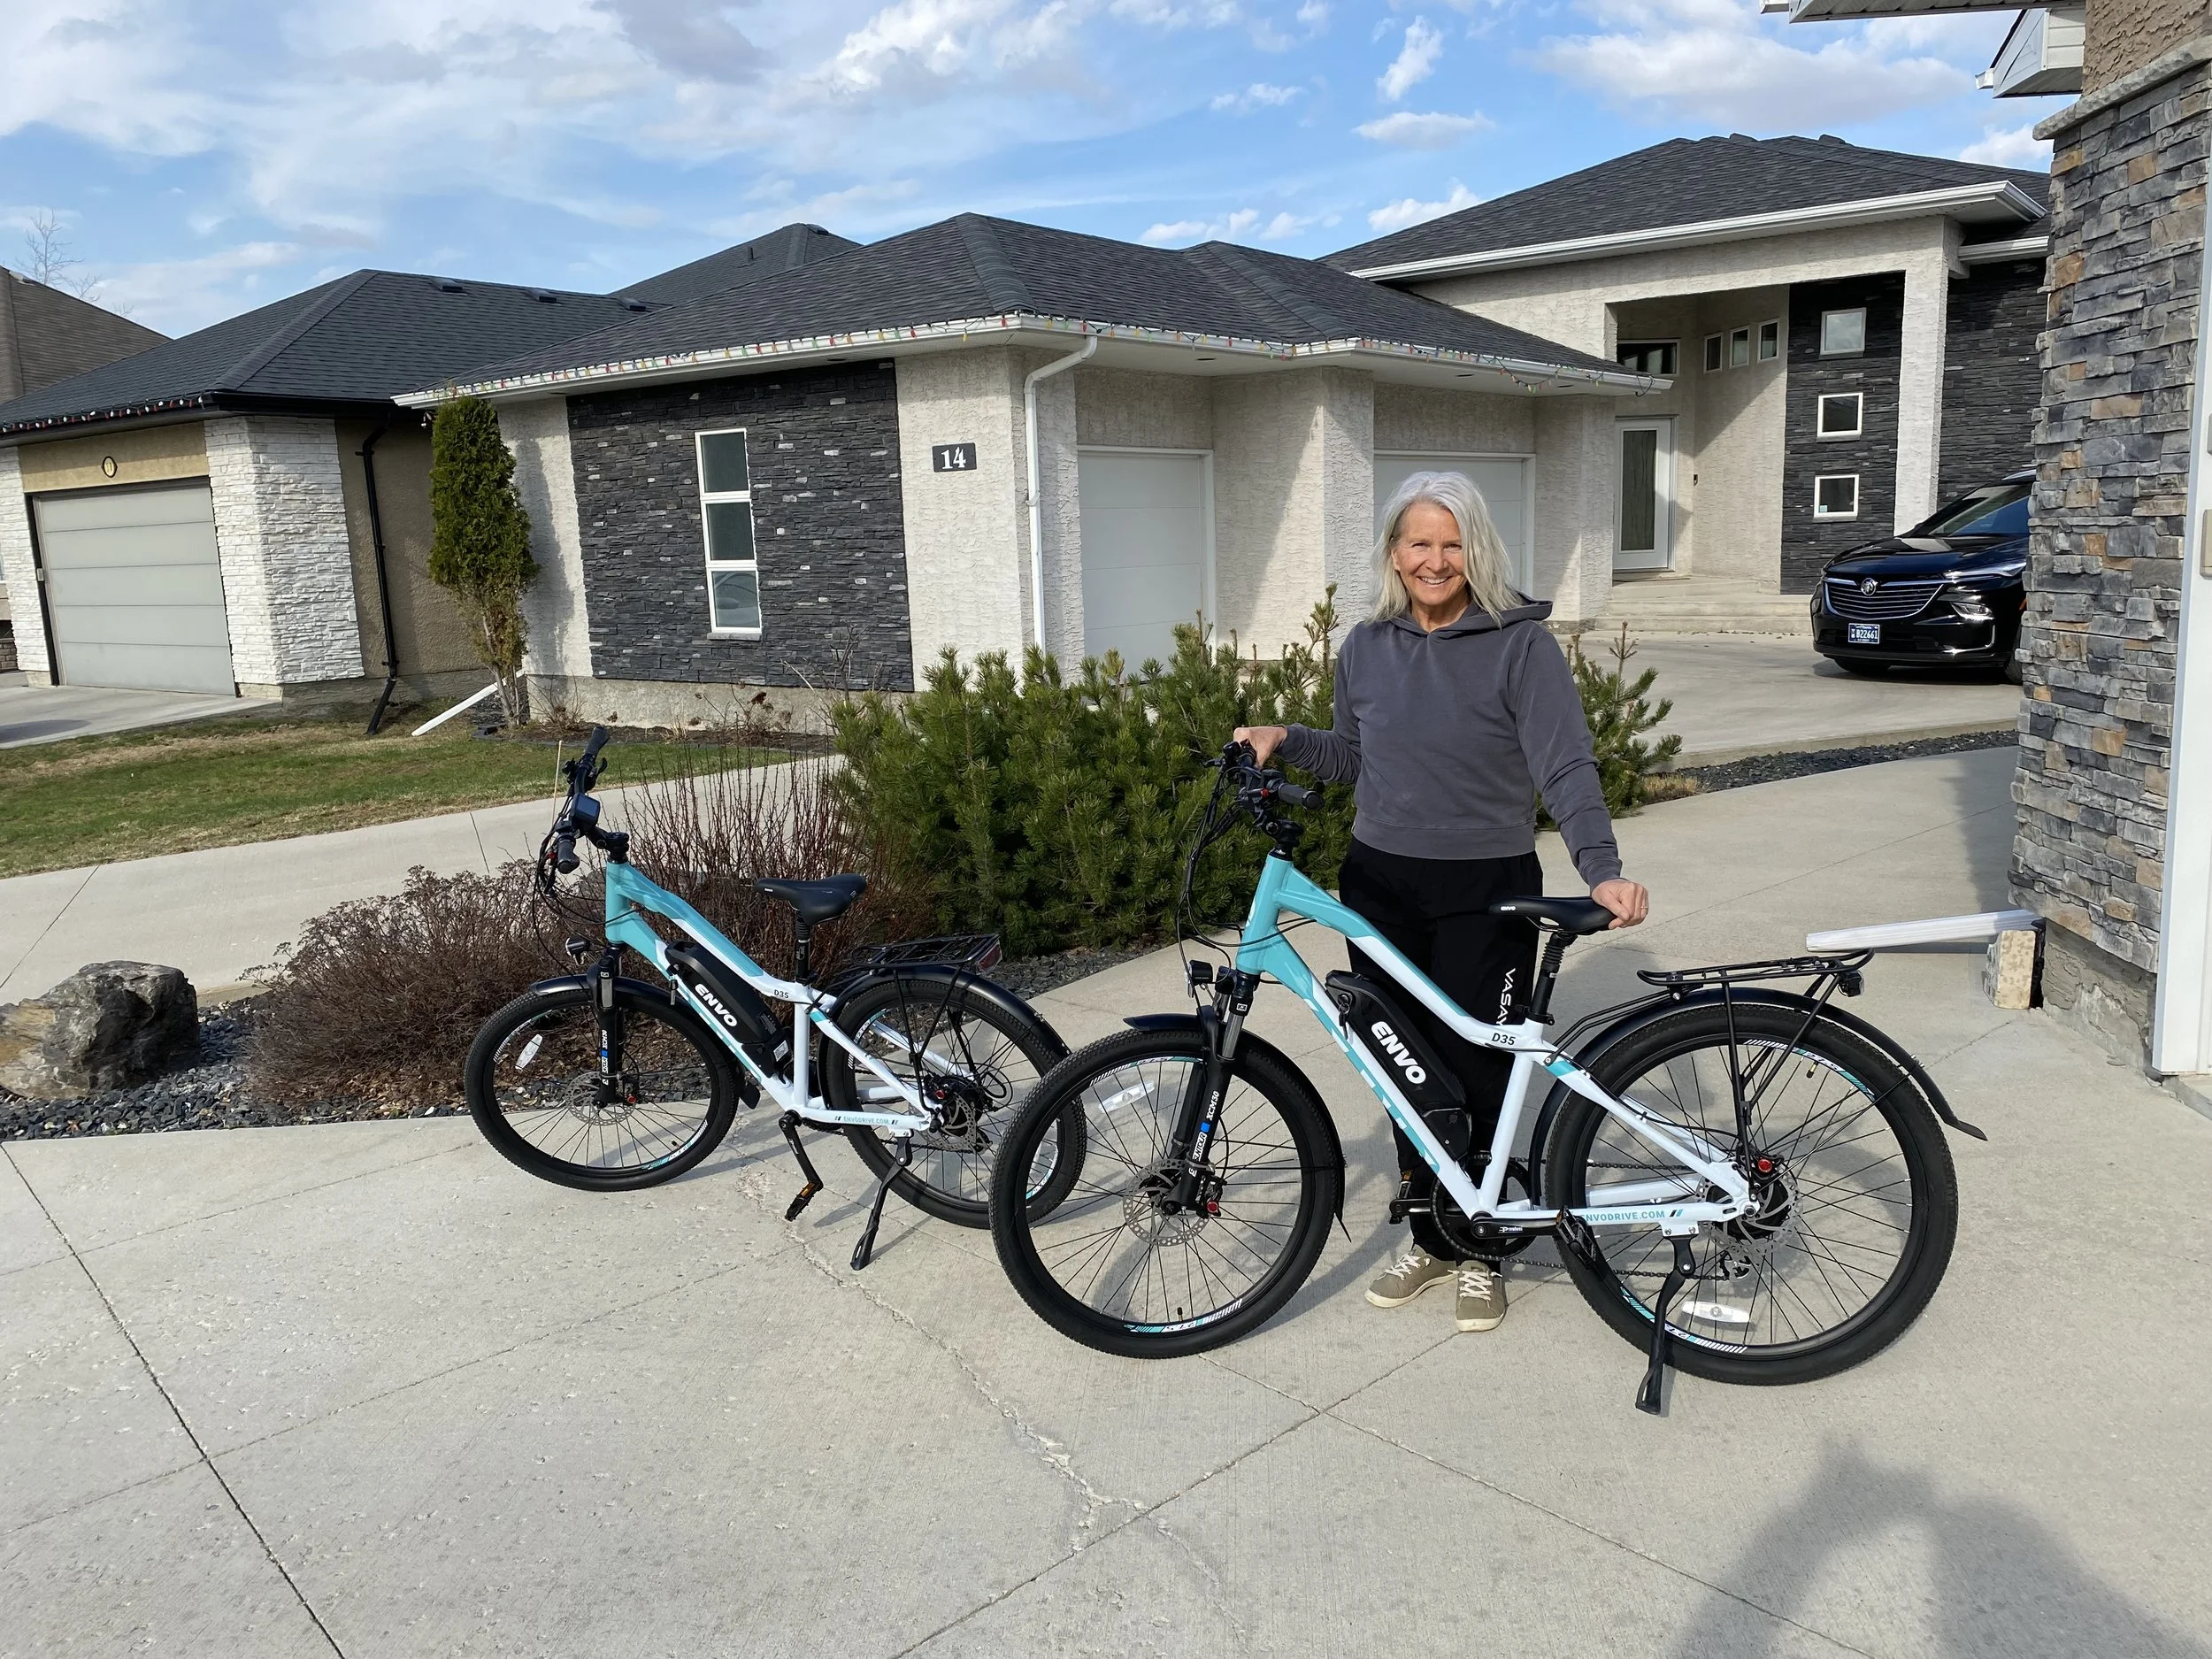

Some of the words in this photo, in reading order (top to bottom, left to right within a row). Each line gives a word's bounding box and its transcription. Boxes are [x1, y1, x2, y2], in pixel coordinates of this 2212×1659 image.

[941, 446, 967, 470] 14
[695, 983, 738, 1027] ENVO
[773, 989, 789, 999] D35
[1491, 1032, 1517, 1046] D35
[1371, 1020, 1426, 1084] ENVO
[1206, 1090, 1220, 1121] XCM30
[1580, 1210, 1665, 1222] NVODRIVE.COM
